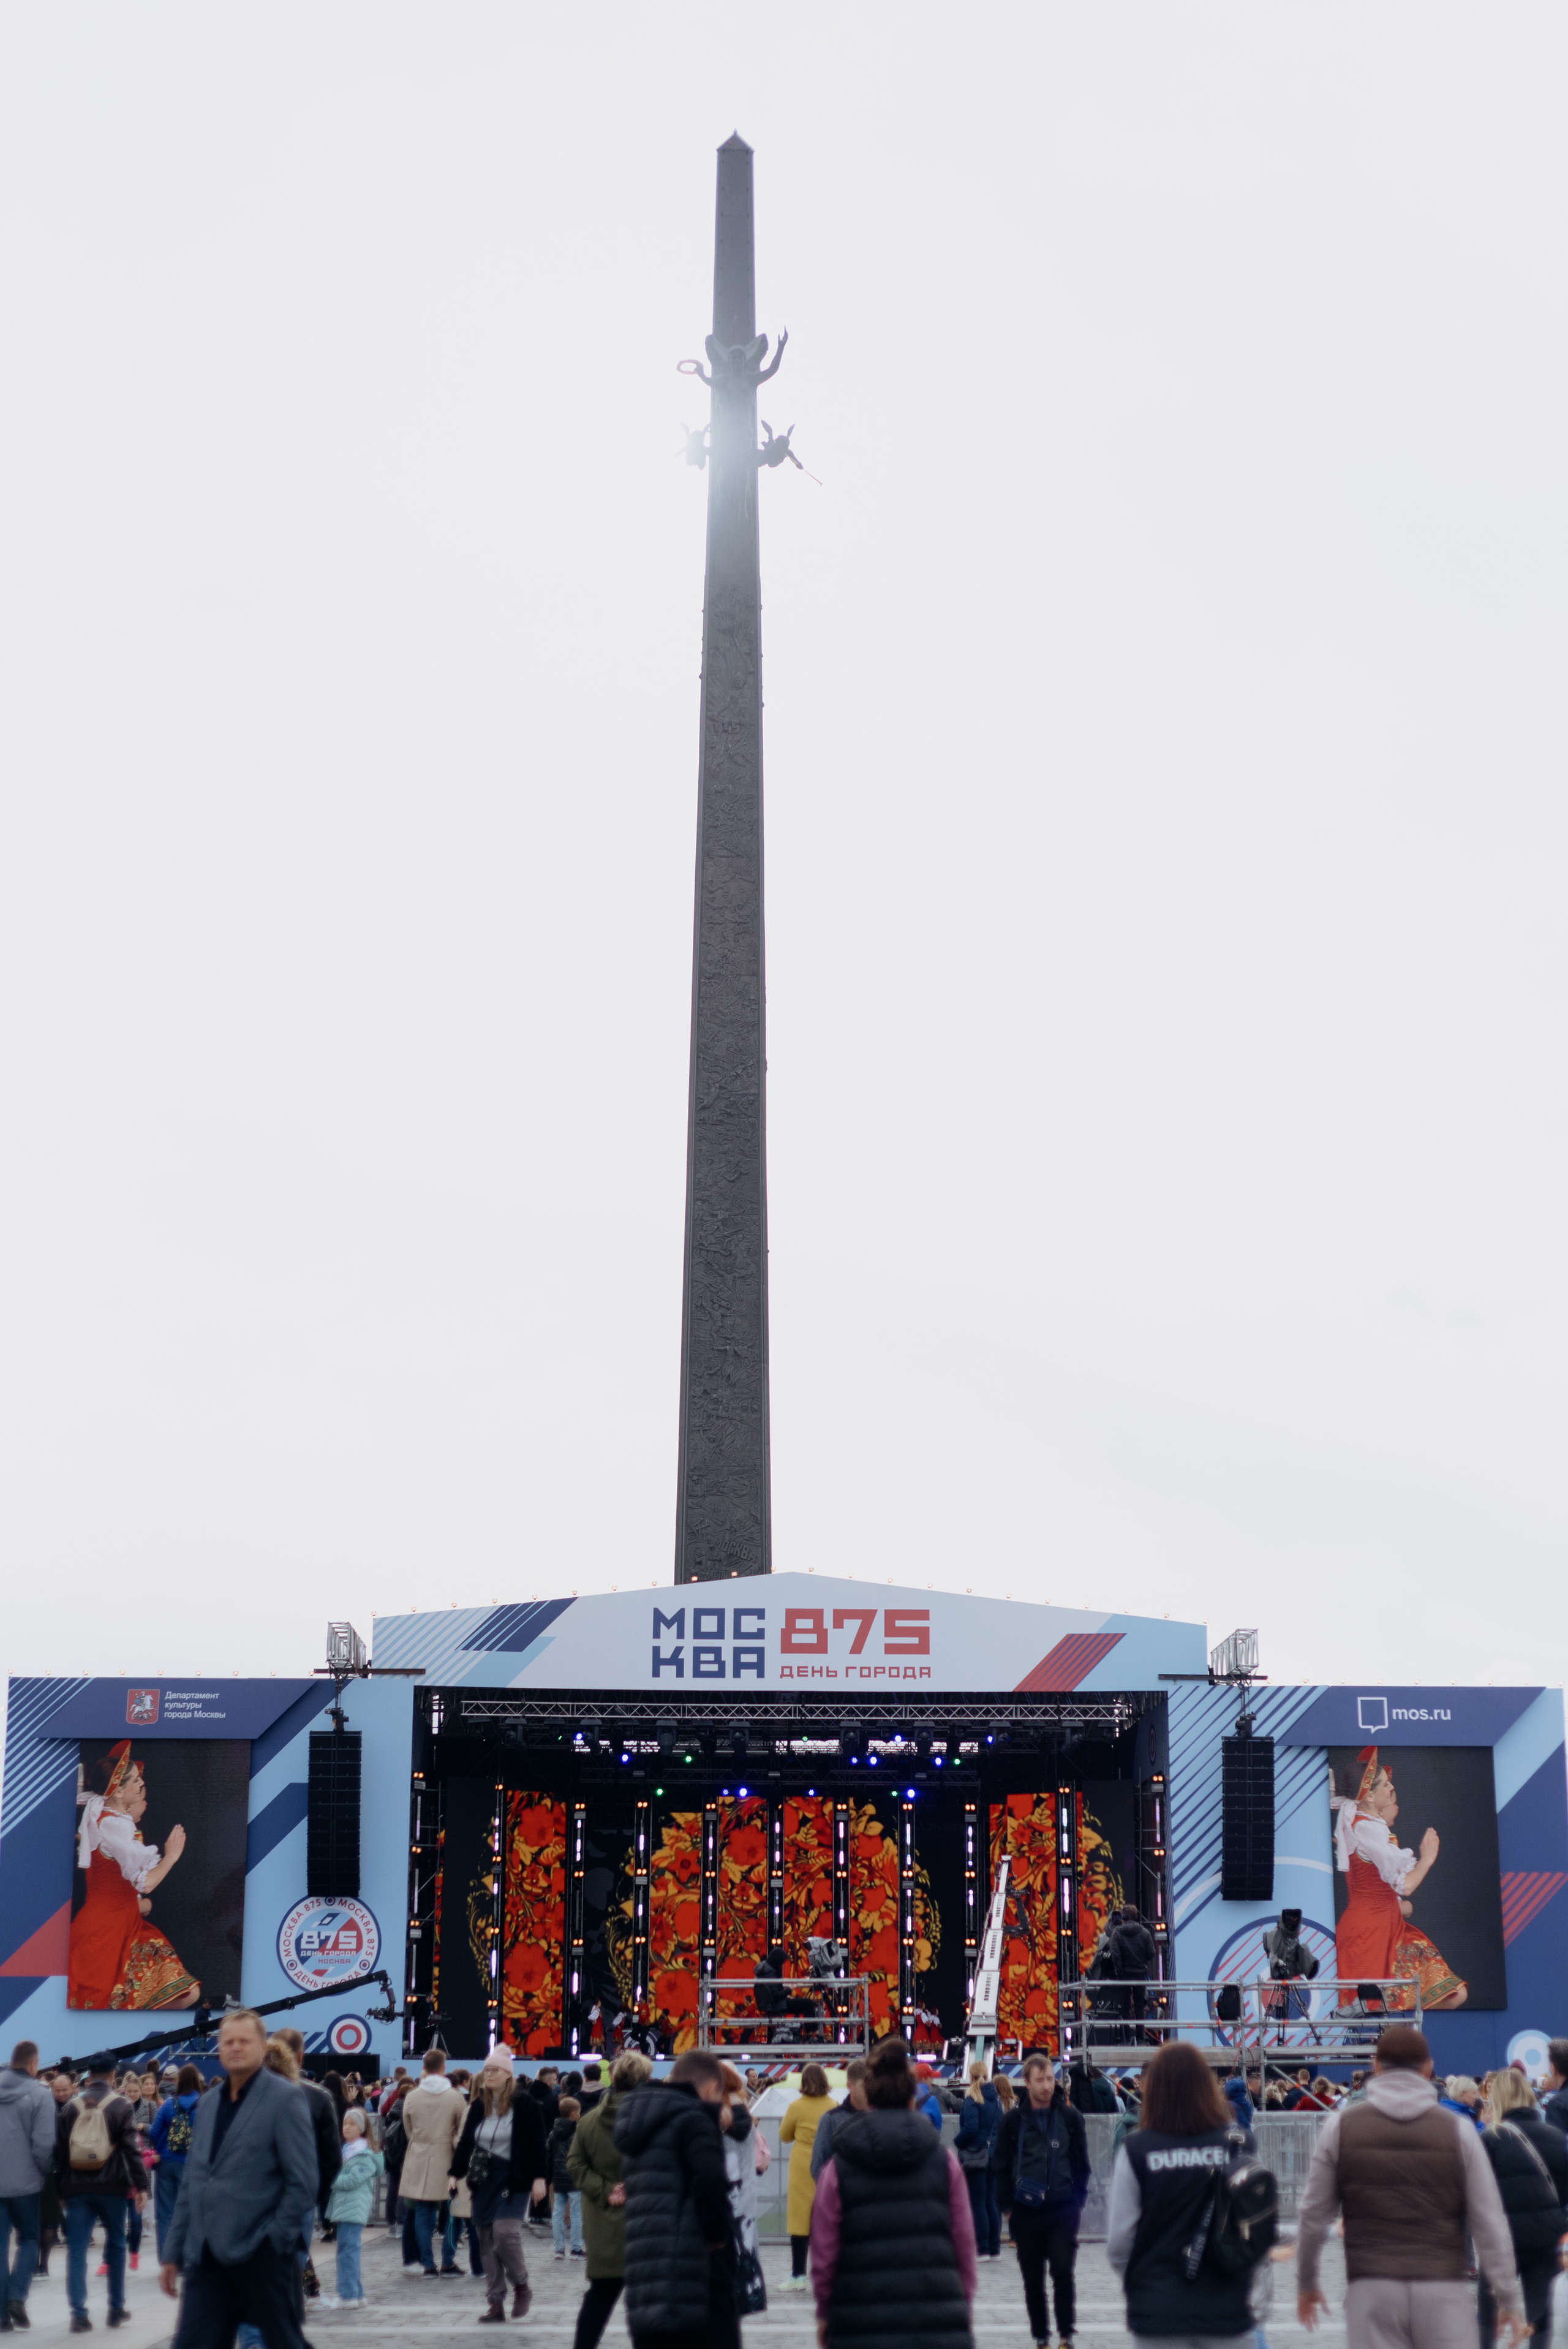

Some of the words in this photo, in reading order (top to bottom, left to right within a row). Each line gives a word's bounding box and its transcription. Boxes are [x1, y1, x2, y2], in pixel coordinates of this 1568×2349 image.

[652, 1607, 766, 1640] МОС
[780, 1608, 930, 1655] 875
[652, 1646, 766, 1679] КВА
[780, 1666, 837, 1679] ДЕНЬ
[845, 1666, 931, 1679] ГОРОДА
[165, 1691, 220, 1700] Департамент
[1392, 1708, 1451, 1720] mos.ru
[283, 1911, 304, 1957] МОСКВА
[304, 1898, 322, 1912] 875
[301, 1931, 357, 1950] 875
[338, 1898, 373, 1935] МОСКВА
[365, 1938, 375, 1957] 875
[294, 1970, 318, 1988] ДЕНЬ
